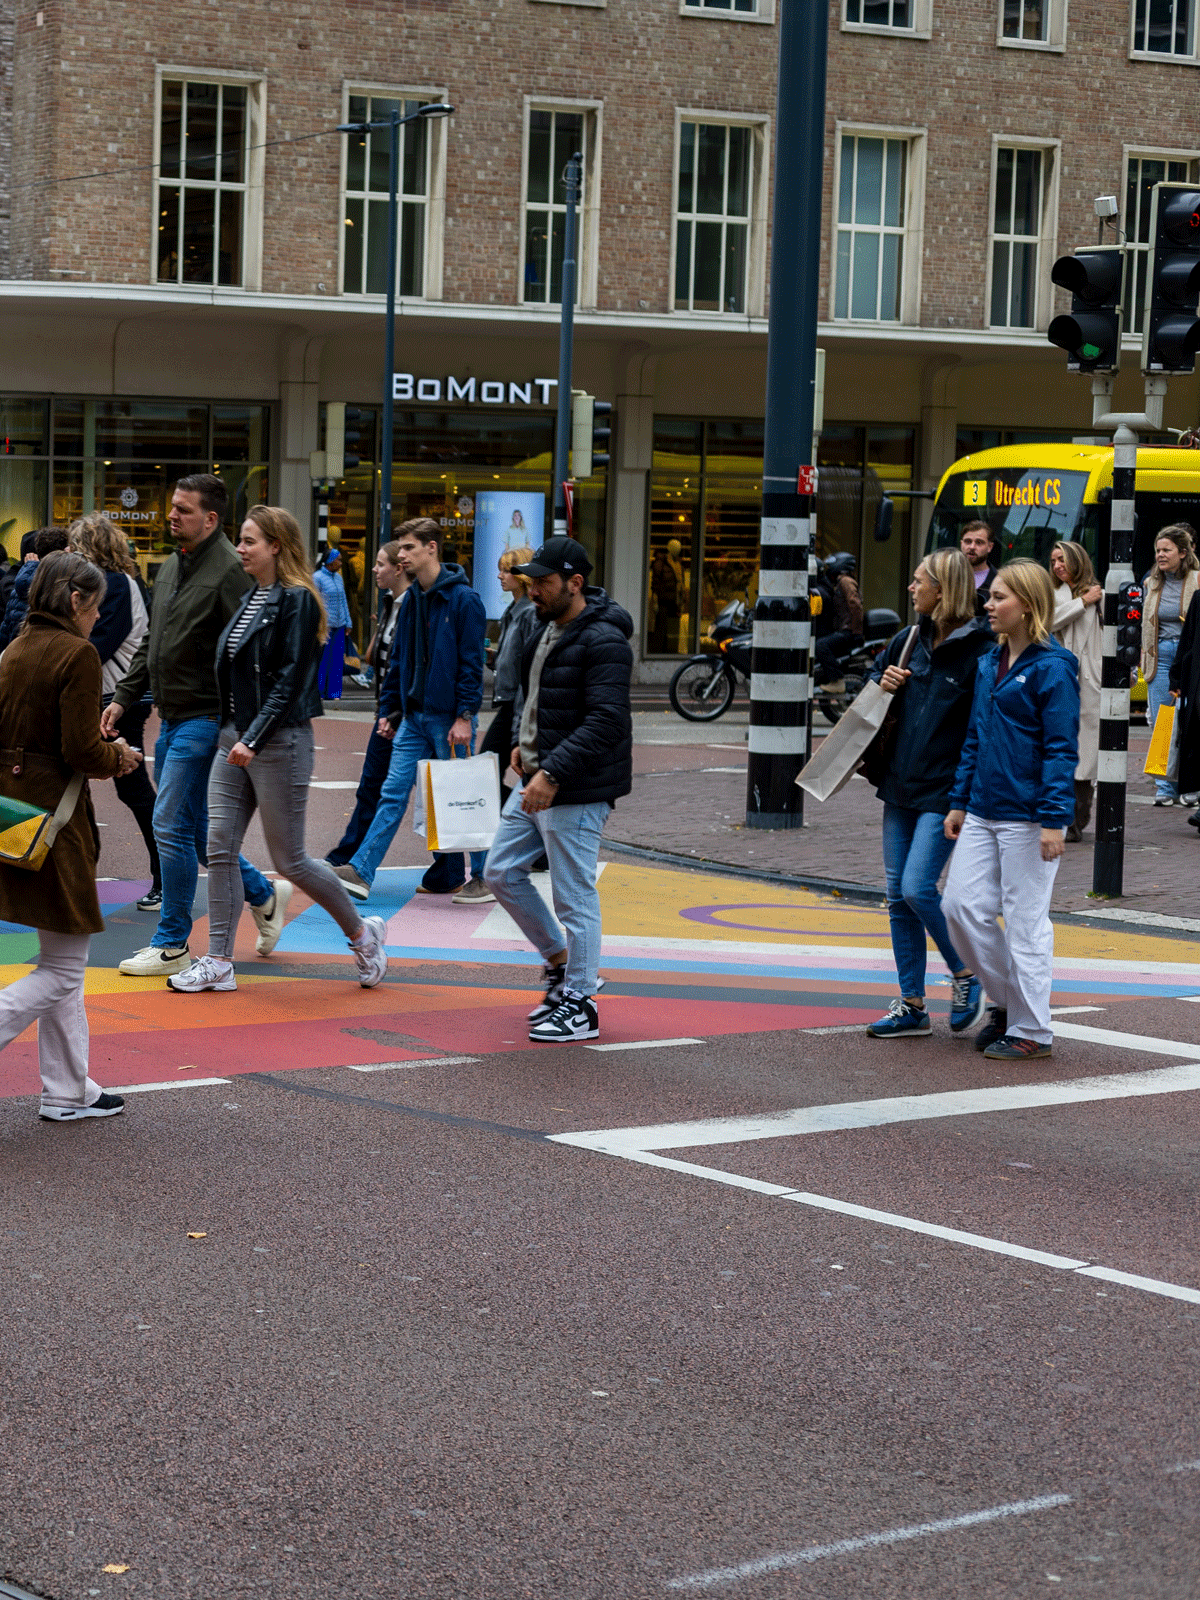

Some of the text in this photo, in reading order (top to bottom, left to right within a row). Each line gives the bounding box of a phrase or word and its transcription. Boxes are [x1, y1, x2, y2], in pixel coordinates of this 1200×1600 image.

[972, 478, 1061, 506] 3 Utrecht CS
